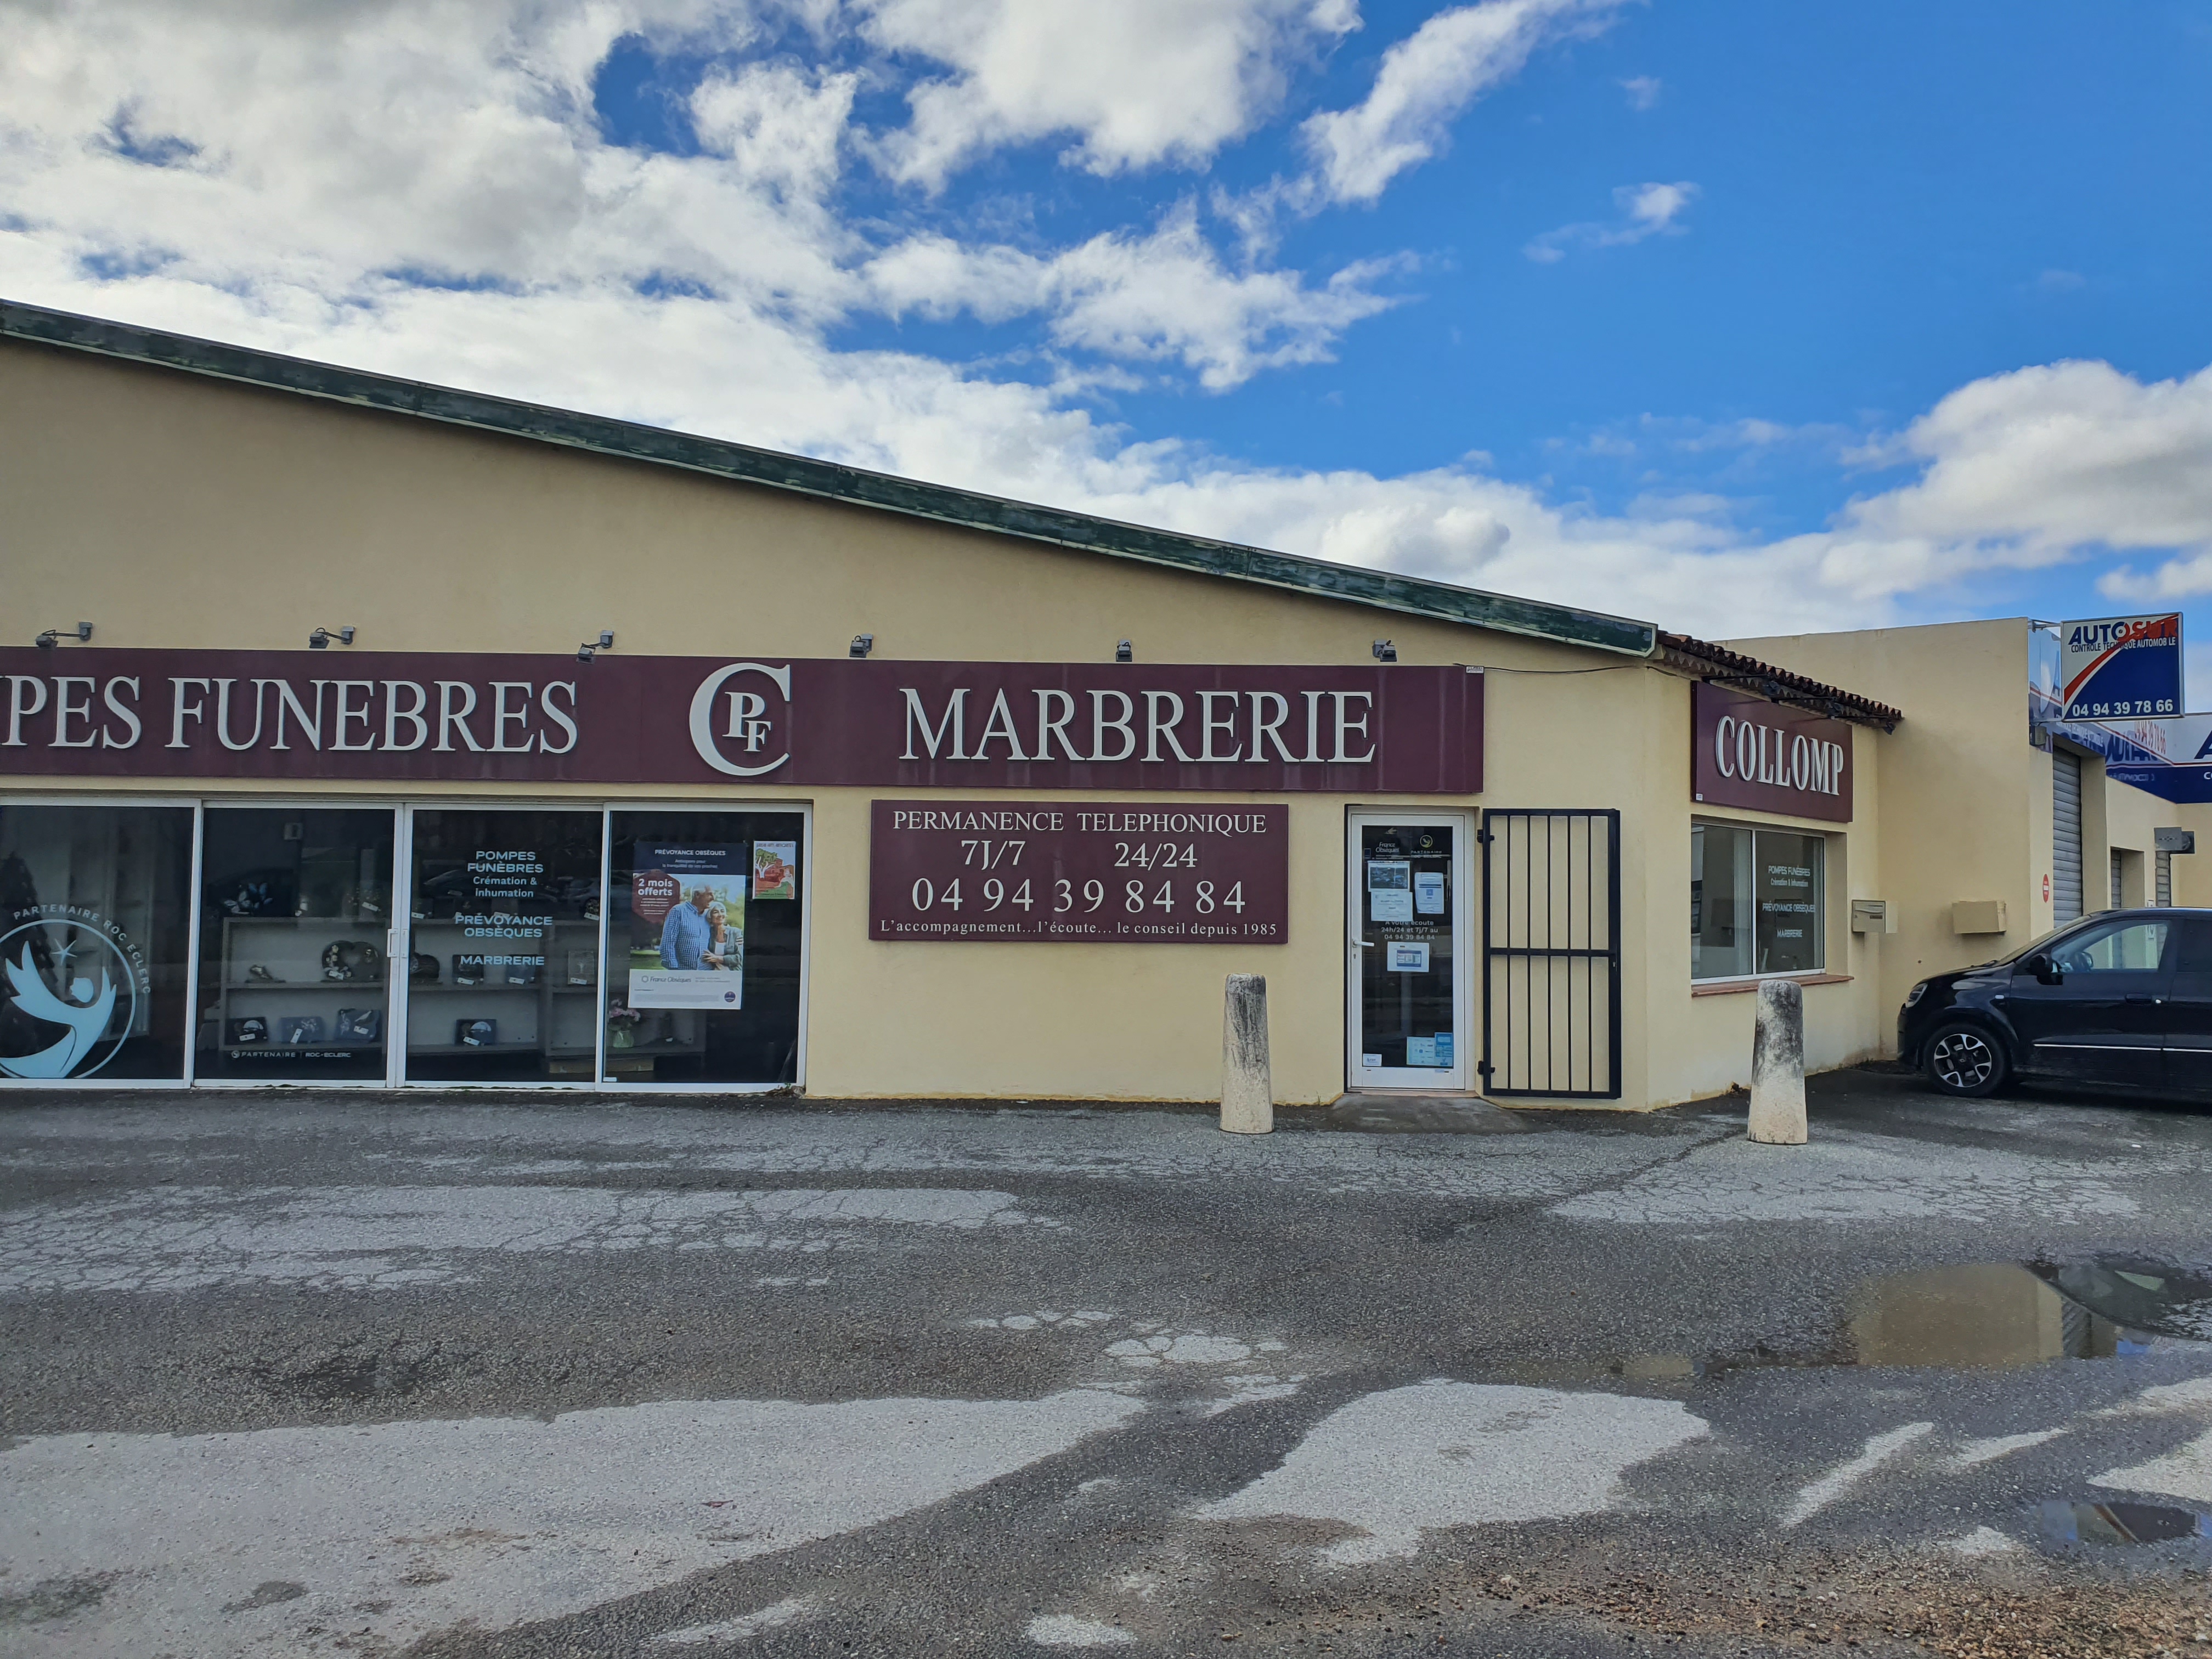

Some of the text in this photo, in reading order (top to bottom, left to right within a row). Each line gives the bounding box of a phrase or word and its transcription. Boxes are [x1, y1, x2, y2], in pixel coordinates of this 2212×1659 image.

[2068, 619, 2178, 645] AUTOSUR
[0, 675, 579, 754] PES FUNEBRES
[2072, 699, 2173, 716] 04 94 39 78 66
[899, 688, 1376, 763] MARBRERIE
[1716, 715, 1844, 796] COLLOMP
[893, 811, 1267, 837] PERMANENCE TELEPHONIQUE
[476, 851, 536, 861] POMPES
[961, 840, 1198, 871] 7J/7 24/24
[467, 861, 544, 873] FUNÈBRES
[1768, 865, 1787, 874] POMPES
[473, 876, 538, 885] Crémation &
[638, 878, 673, 887] 2 mois
[637, 887, 673, 896] offerts
[912, 878, 1245, 913] 04 94 39 84 84
[455, 912, 553, 926] PRÉVOYANCE
[464, 925, 543, 939] OBSÈQUES
[1118, 922, 1129, 934] le
[1135, 922, 1185, 934] conseil
[1190, 922, 1237, 937] depuis
[1243, 923, 1277, 935] 1985
[13, 904, 151, 994] PARTENAIRE ROC ECLERC
[460, 955, 545, 966] MARBRERIE
